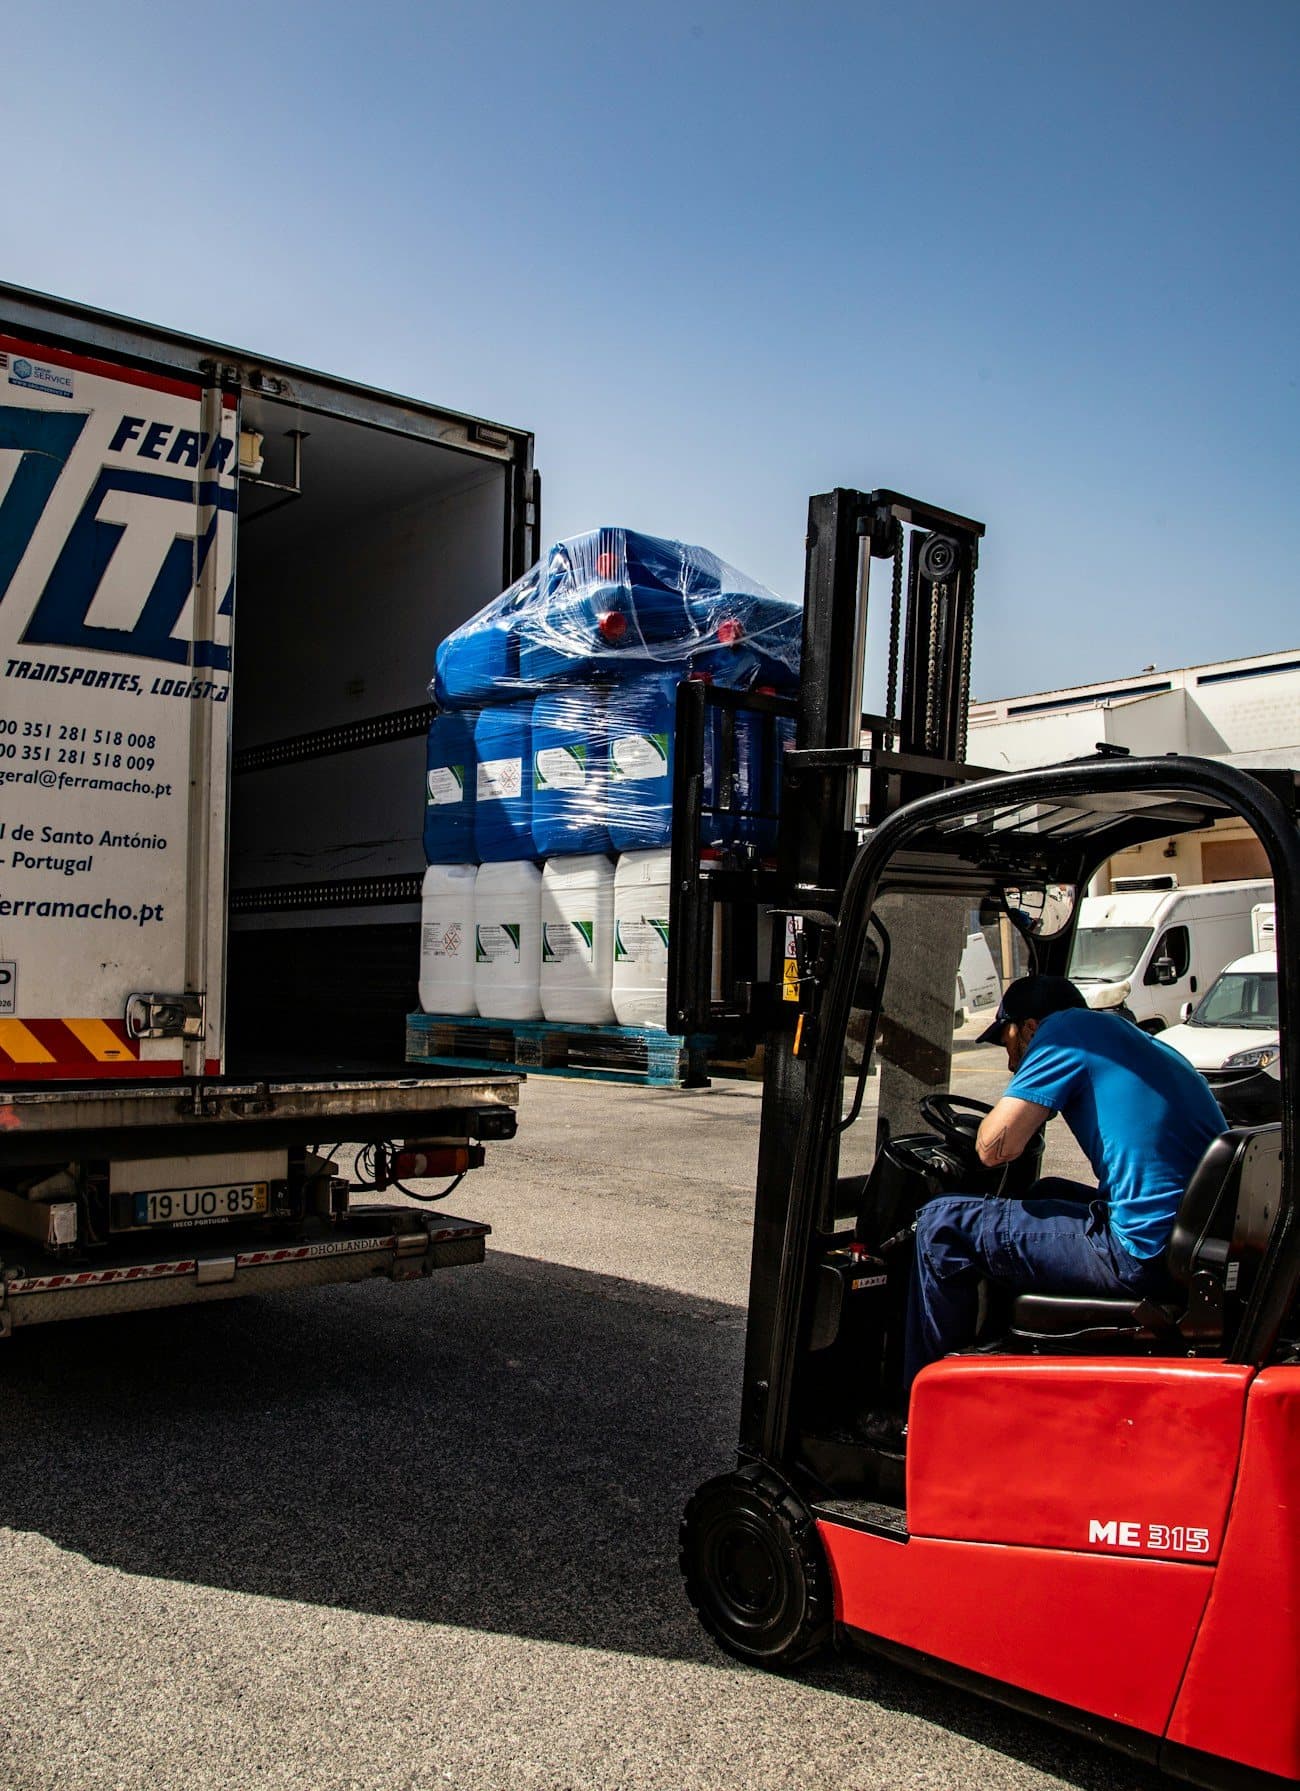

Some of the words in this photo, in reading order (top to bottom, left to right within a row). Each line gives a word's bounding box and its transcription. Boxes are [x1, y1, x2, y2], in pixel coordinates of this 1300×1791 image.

[33, 371, 72, 386] SERVICE
[108, 415, 239, 476] FERR
[5, 659, 143, 696] TRANSPORTES,
[22, 722, 51, 738] 351
[58, 725, 87, 741] 281
[93, 729, 122, 746] 518
[127, 732, 156, 749] 008
[21, 745, 50, 761] 351
[57, 748, 86, 764] 281
[92, 752, 121, 768] 518
[126, 756, 155, 772] 009
[0, 769, 172, 798] geral@ferramacho.pt
[11, 824, 34, 841] de
[41, 826, 94, 846] Santo
[99, 830, 167, 850] António
[12, 851, 93, 876] Portugal
[0, 893, 164, 927] erramacho.pt
[194, 1217, 229, 1226] PORTUGAL
[311, 1240, 380, 1256] DHOLLANDIA
[1089, 1520, 1141, 1547] ME
[1147, 1524, 1210, 1553] 315
